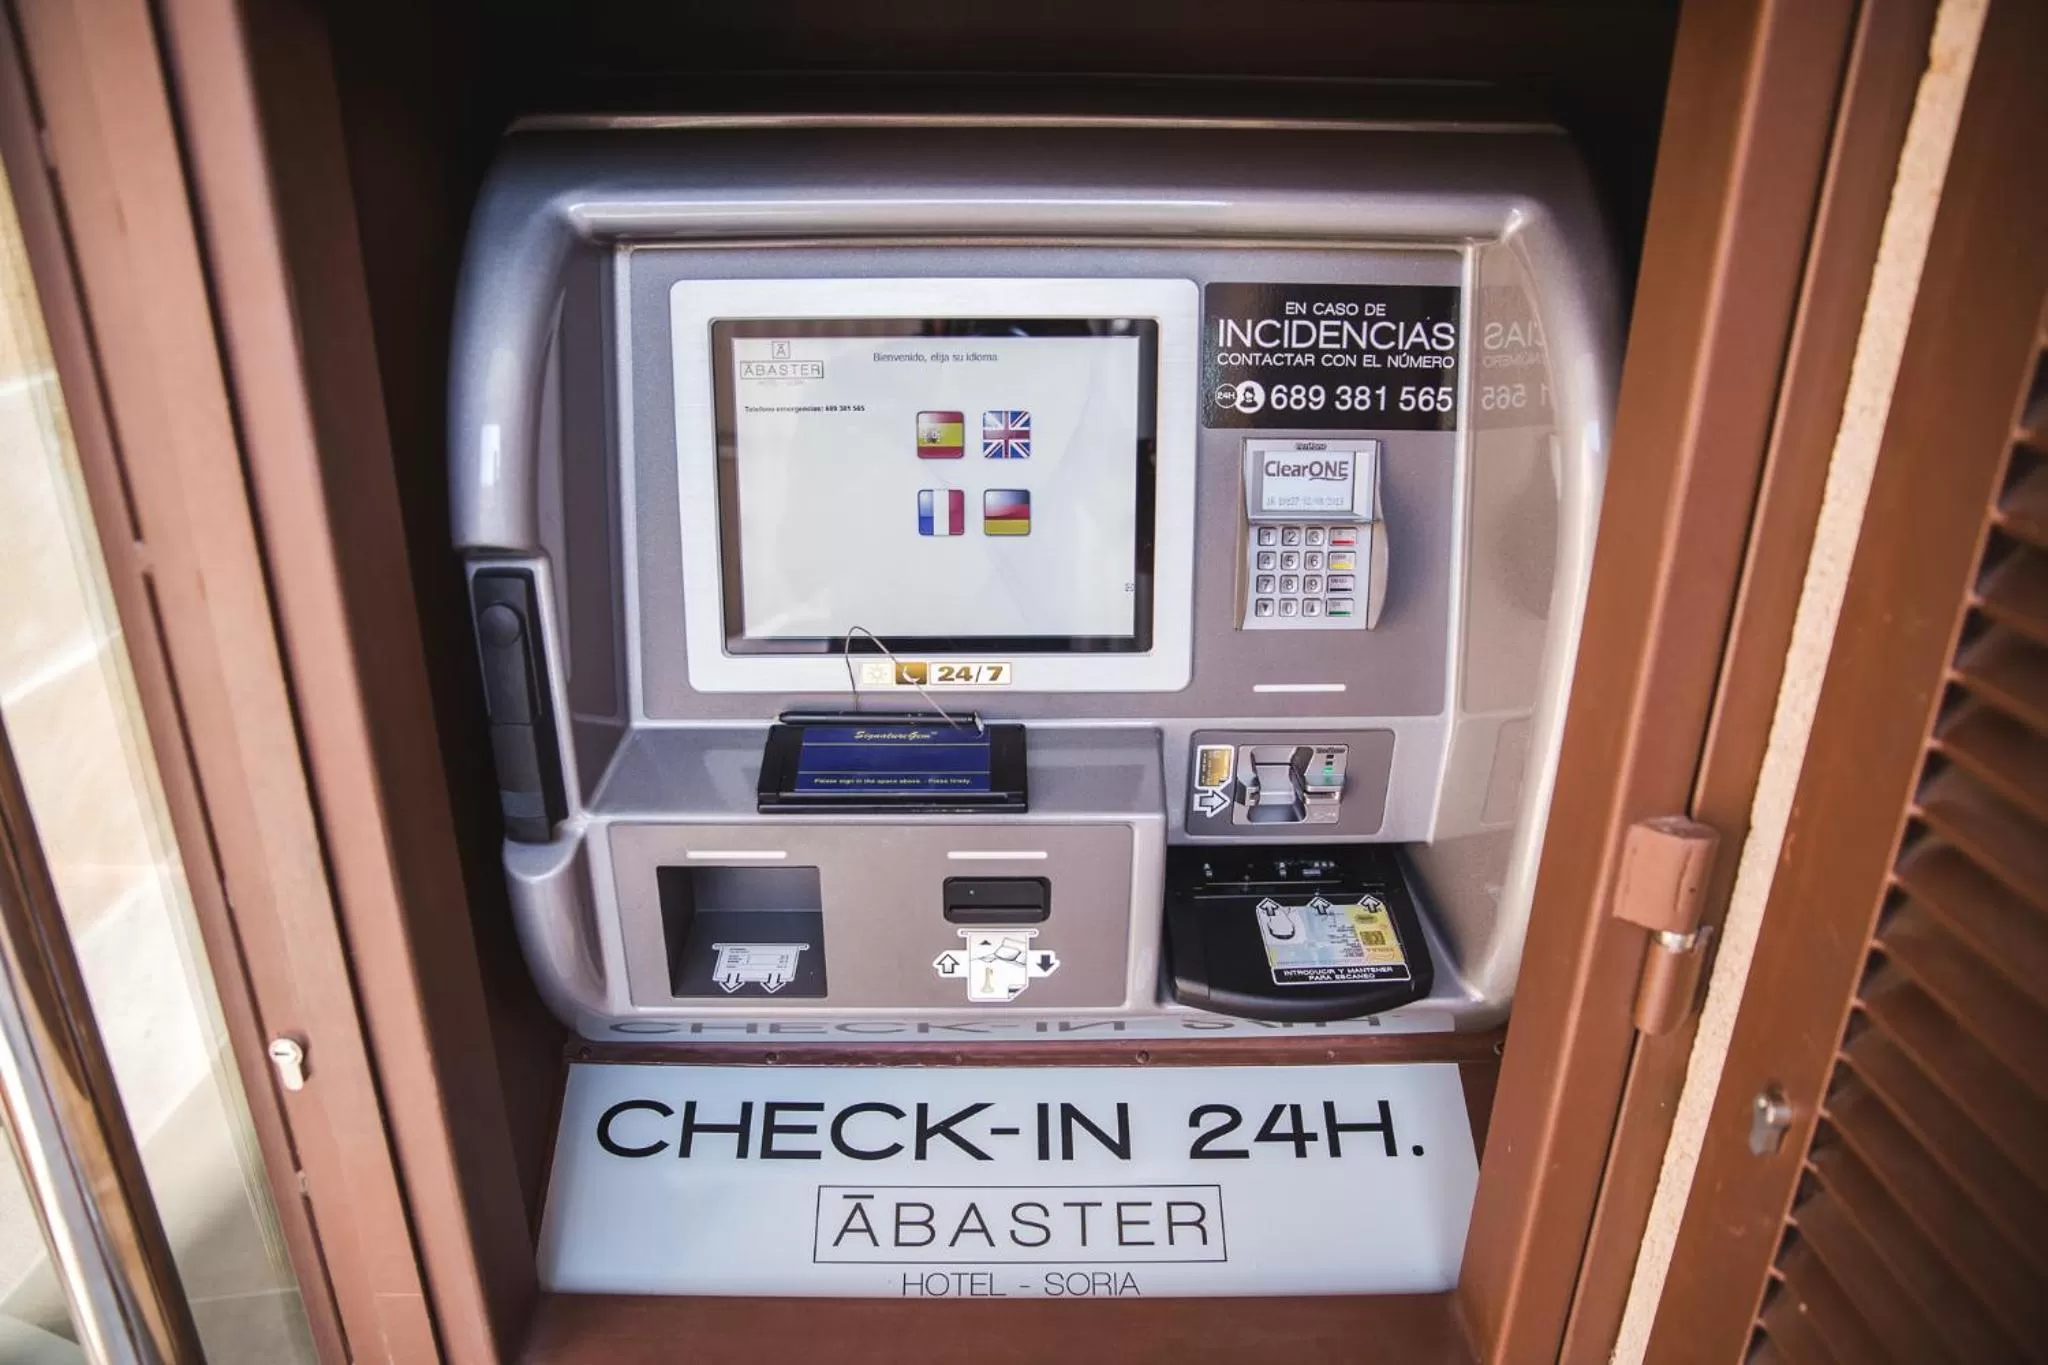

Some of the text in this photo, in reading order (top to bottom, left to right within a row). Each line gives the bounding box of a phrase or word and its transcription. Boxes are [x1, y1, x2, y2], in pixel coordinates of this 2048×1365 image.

[1285, 302, 1387, 316] EN CASO DE
[1218, 319, 1455, 351] INCIDENCIAS
[1217, 352, 1455, 369] CONTACTAR CON EL NÚMERO
[1217, 391, 1236, 400] 24H
[1270, 384, 1453, 412] 689 381 565
[1264, 460, 1350, 478] ClearONE
[937, 665, 1004, 684] 24/7
[596, 1099, 1425, 1161] CHECK-IN 24H.
[833, 1194, 1209, 1247] ĀBASTER
[902, 1272, 1007, 1296] HOTEL
[1044, 1271, 1141, 1296] SORIA
